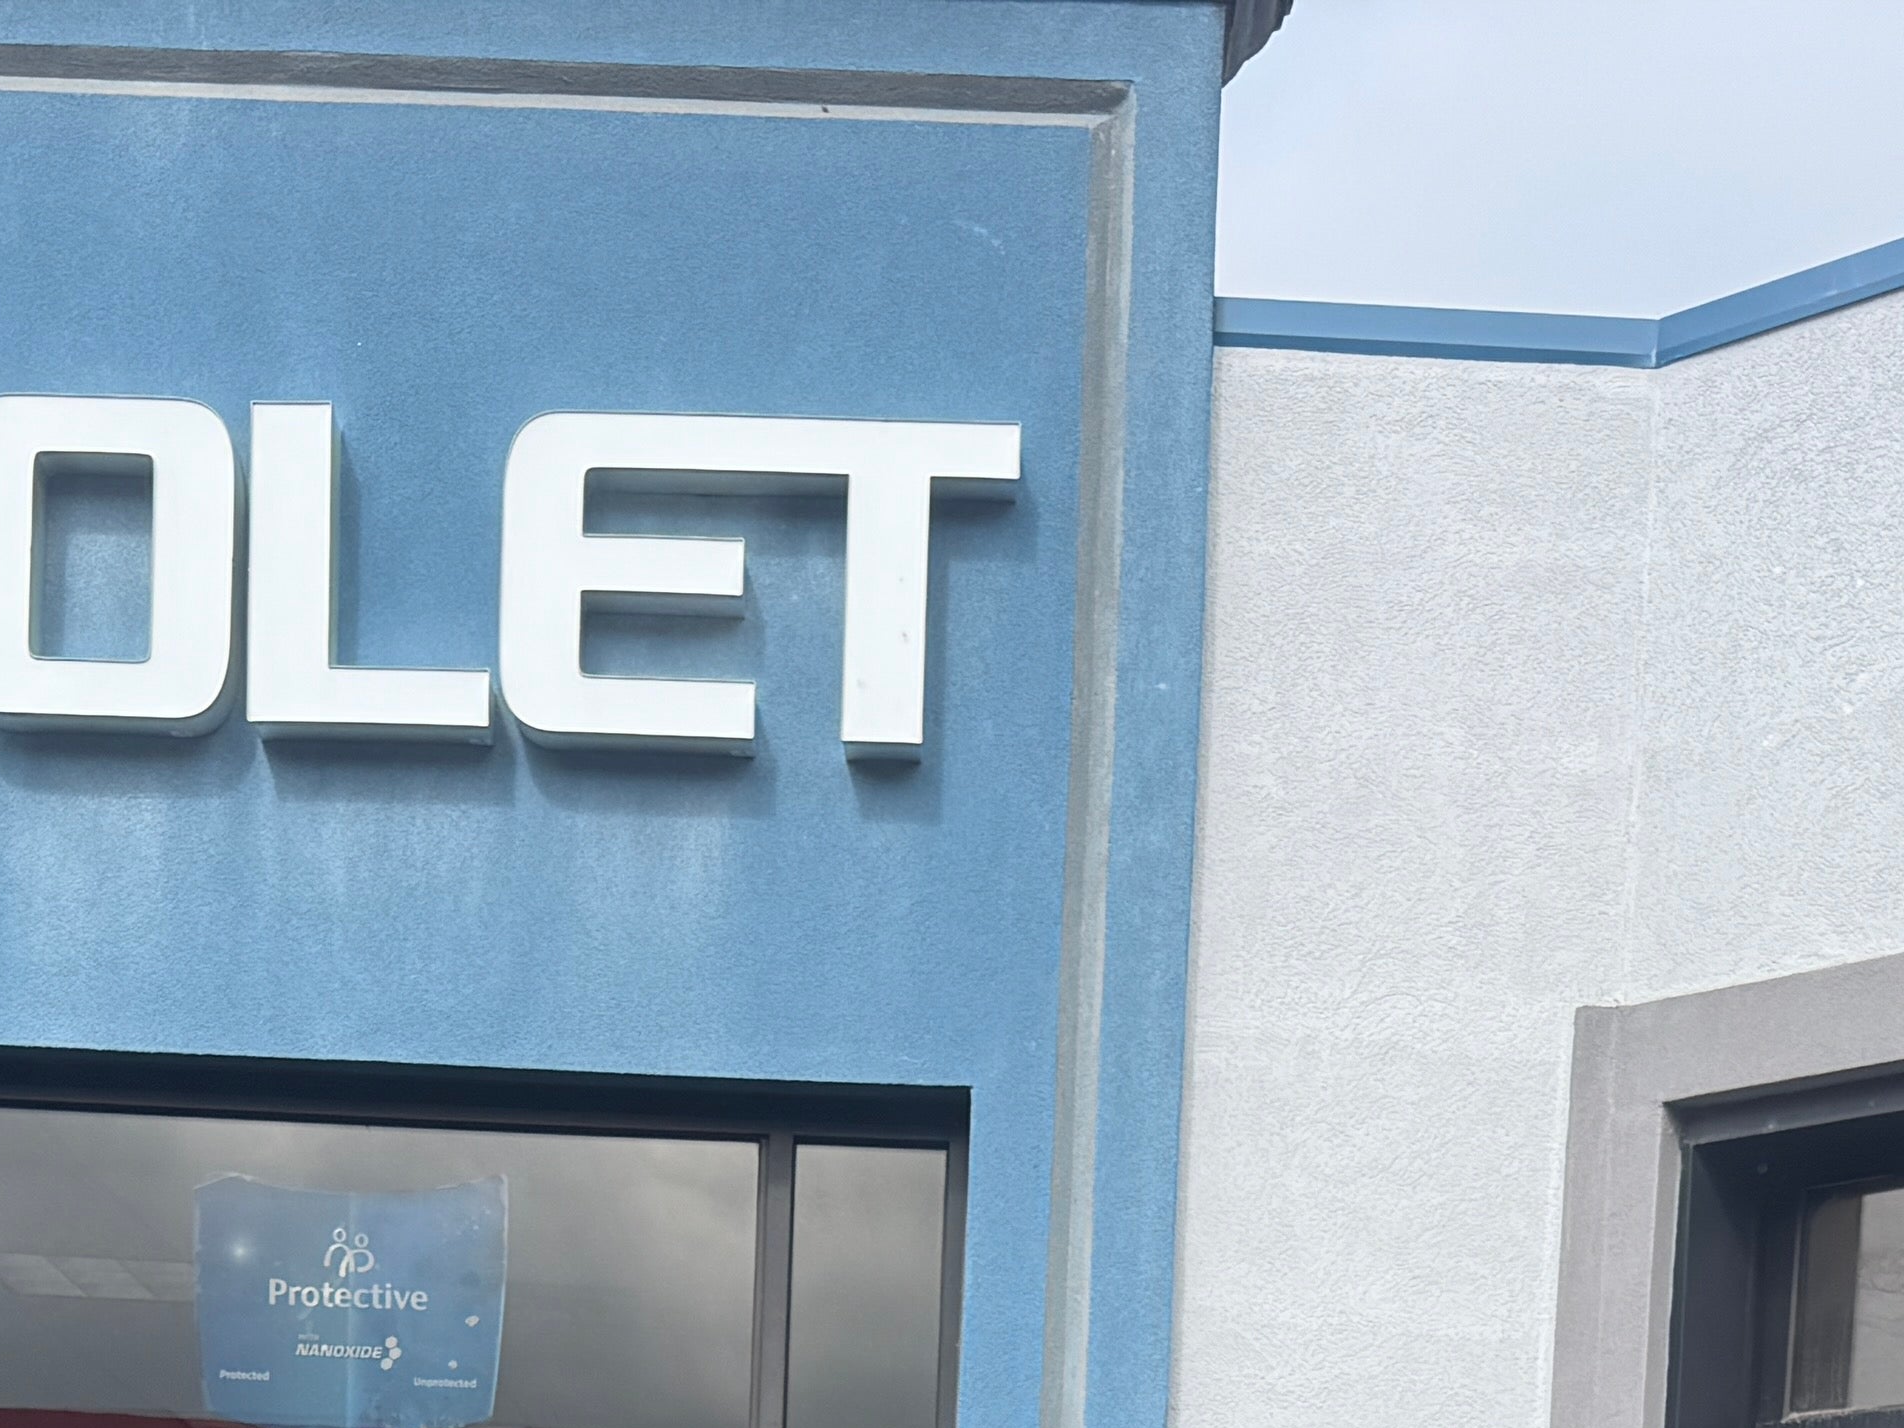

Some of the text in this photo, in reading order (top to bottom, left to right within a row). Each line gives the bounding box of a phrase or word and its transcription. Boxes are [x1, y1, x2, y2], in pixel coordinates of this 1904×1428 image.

[267, 1277, 429, 1312] Protective
[295, 1343, 384, 1359] NANOXIDE
[218, 1369, 271, 1382] Protected
[413, 1376, 478, 1390] Unprotected
